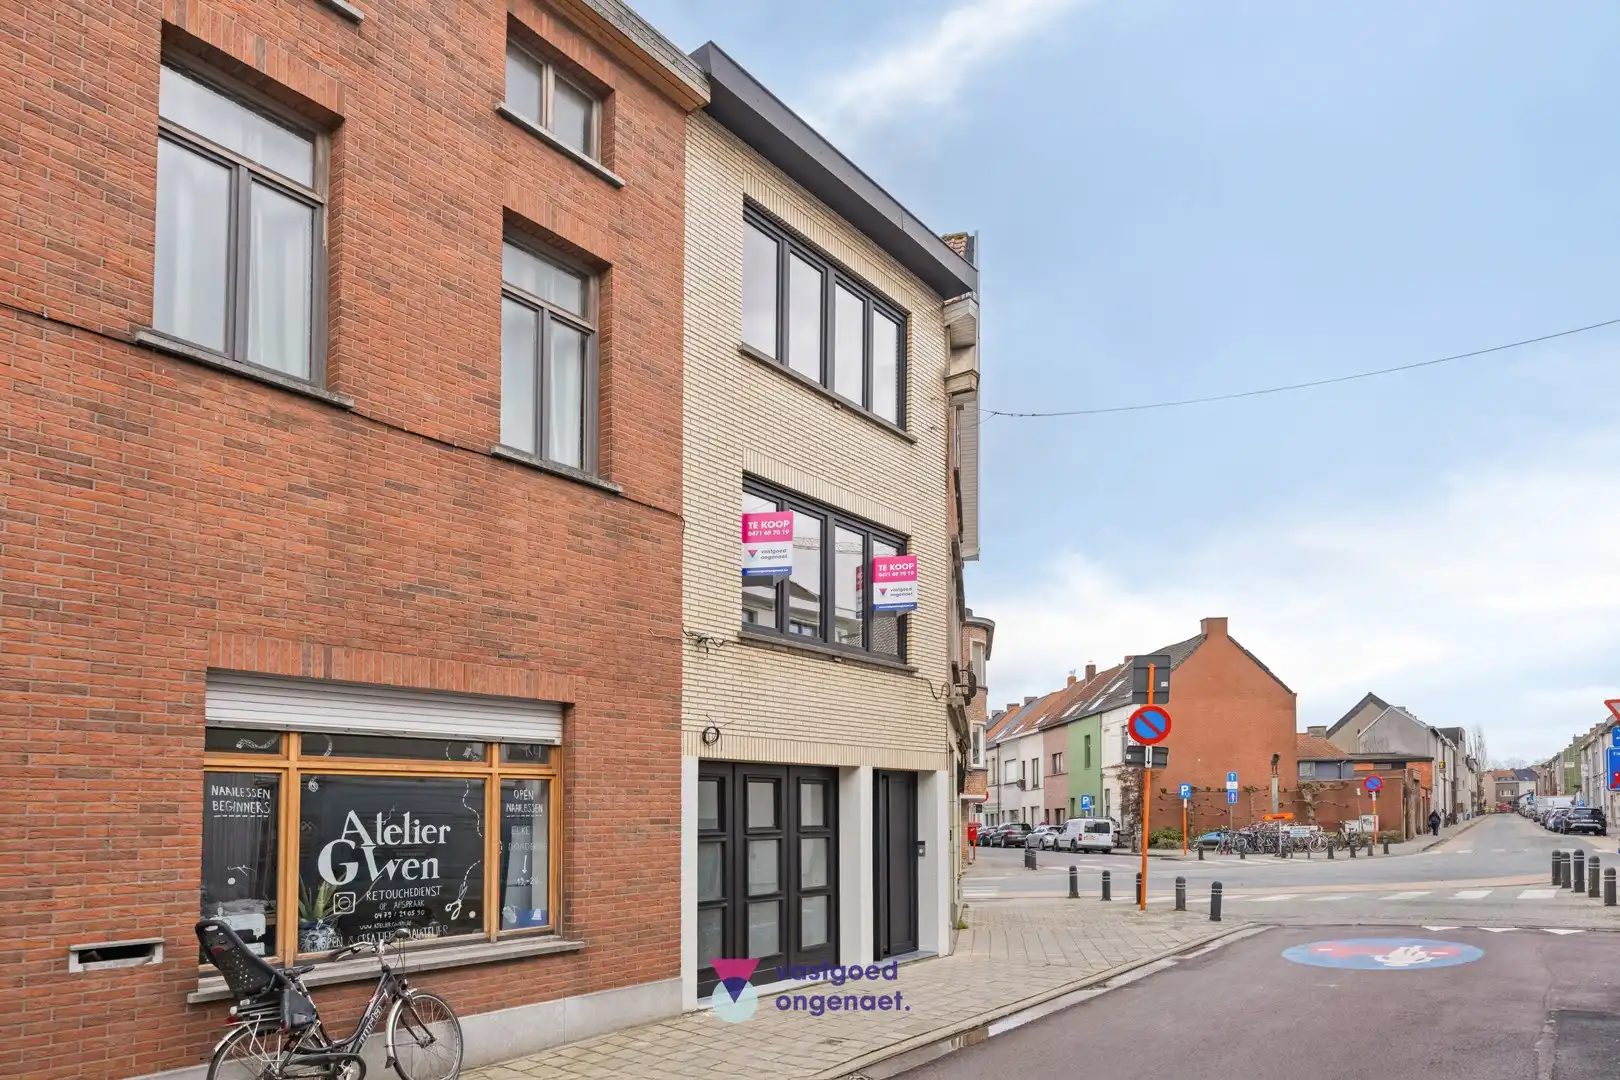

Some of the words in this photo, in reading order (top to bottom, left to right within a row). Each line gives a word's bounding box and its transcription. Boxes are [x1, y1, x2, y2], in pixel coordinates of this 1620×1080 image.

[748, 521, 758, 530] TE
[761, 520, 790, 529] KOOP
[890, 563, 914, 571] KOOP
[211, 785, 271, 799] NAAILESSEN
[513, 790, 534, 800] OPEN
[1180, 785, 1189, 796] P
[1082, 796, 1090, 805] P
[212, 800, 271, 814] BEGINNERS
[341, 810, 451, 846] Atelier
[366, 886, 442, 901] RETOUCHEDIENST
[379, 902, 388, 910] OP
[394, 900, 425, 909] AFSPRAAK
